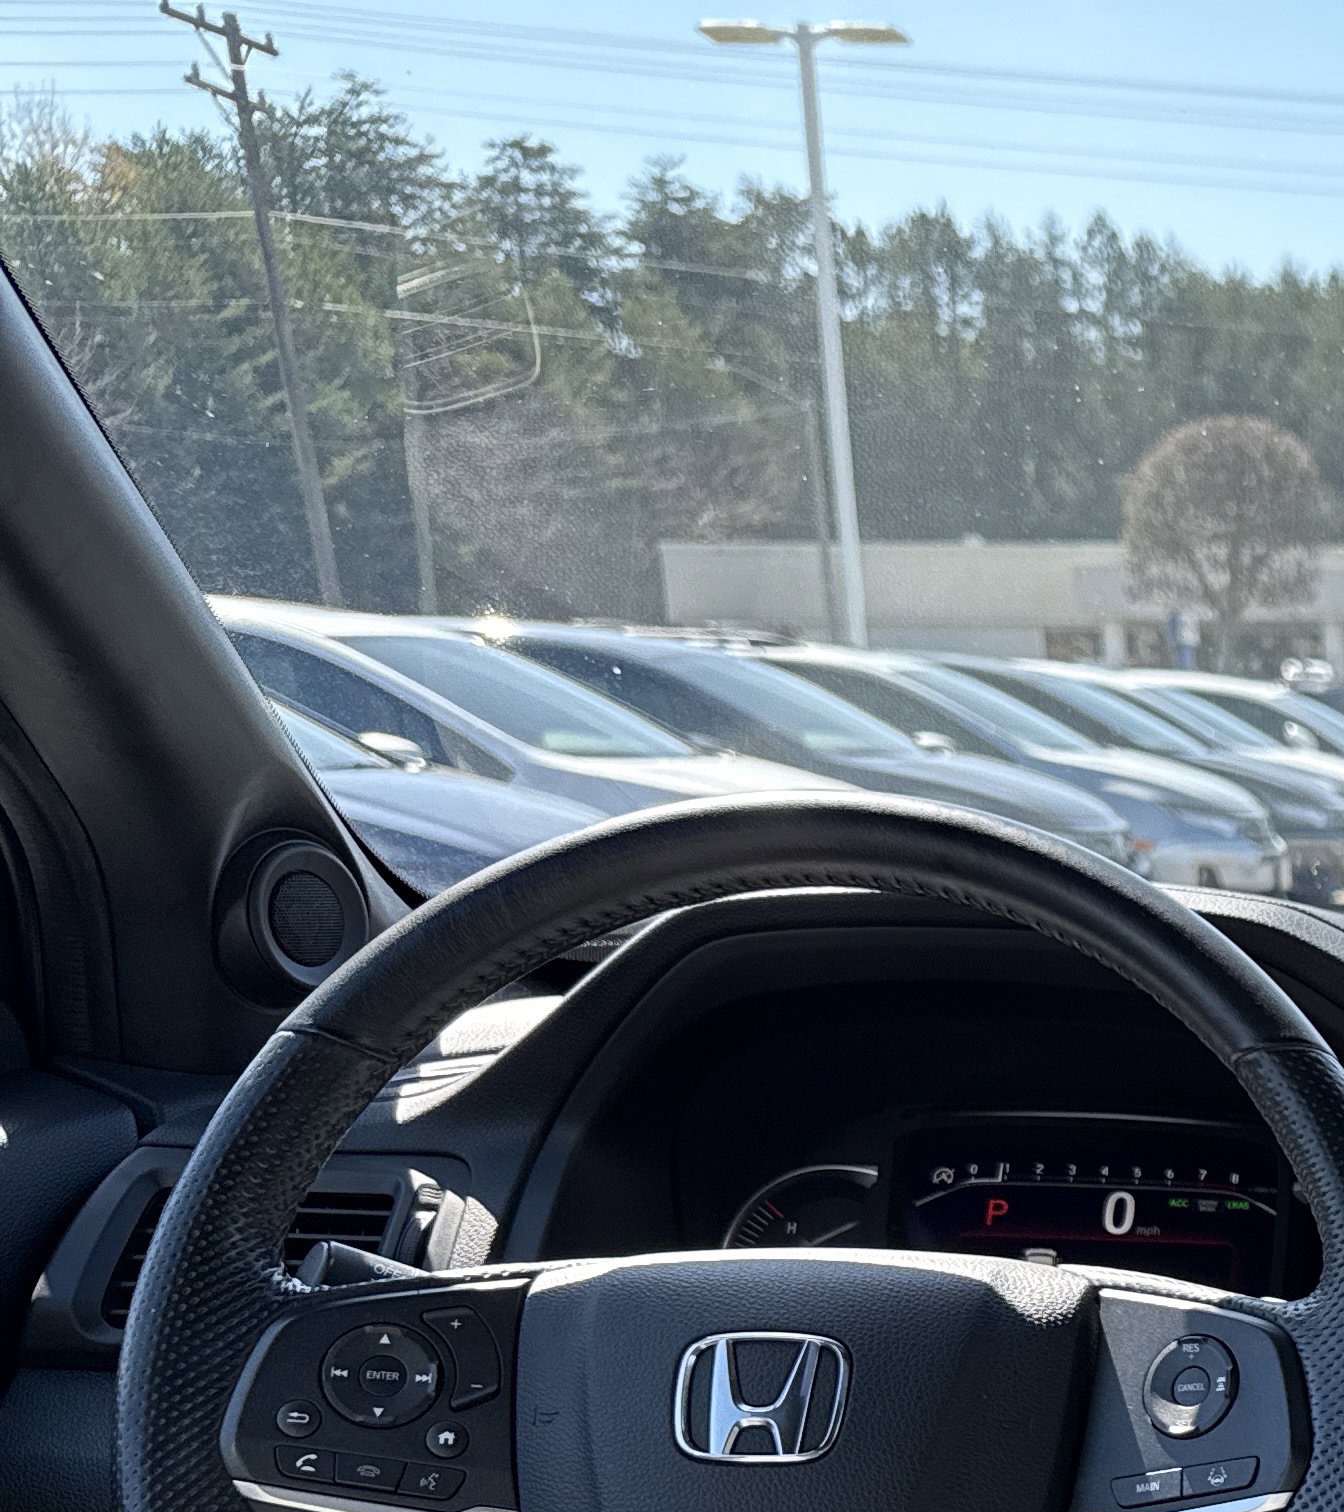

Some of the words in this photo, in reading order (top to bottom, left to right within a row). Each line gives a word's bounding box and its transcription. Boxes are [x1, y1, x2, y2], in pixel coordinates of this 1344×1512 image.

[985, 1198, 1009, 1226] P
[1103, 1190, 1136, 1235] 0
[786, 1221, 798, 1234] H
[366, 1369, 400, 1382] ENTER
[1136, 1480, 1161, 1494] MAIN
